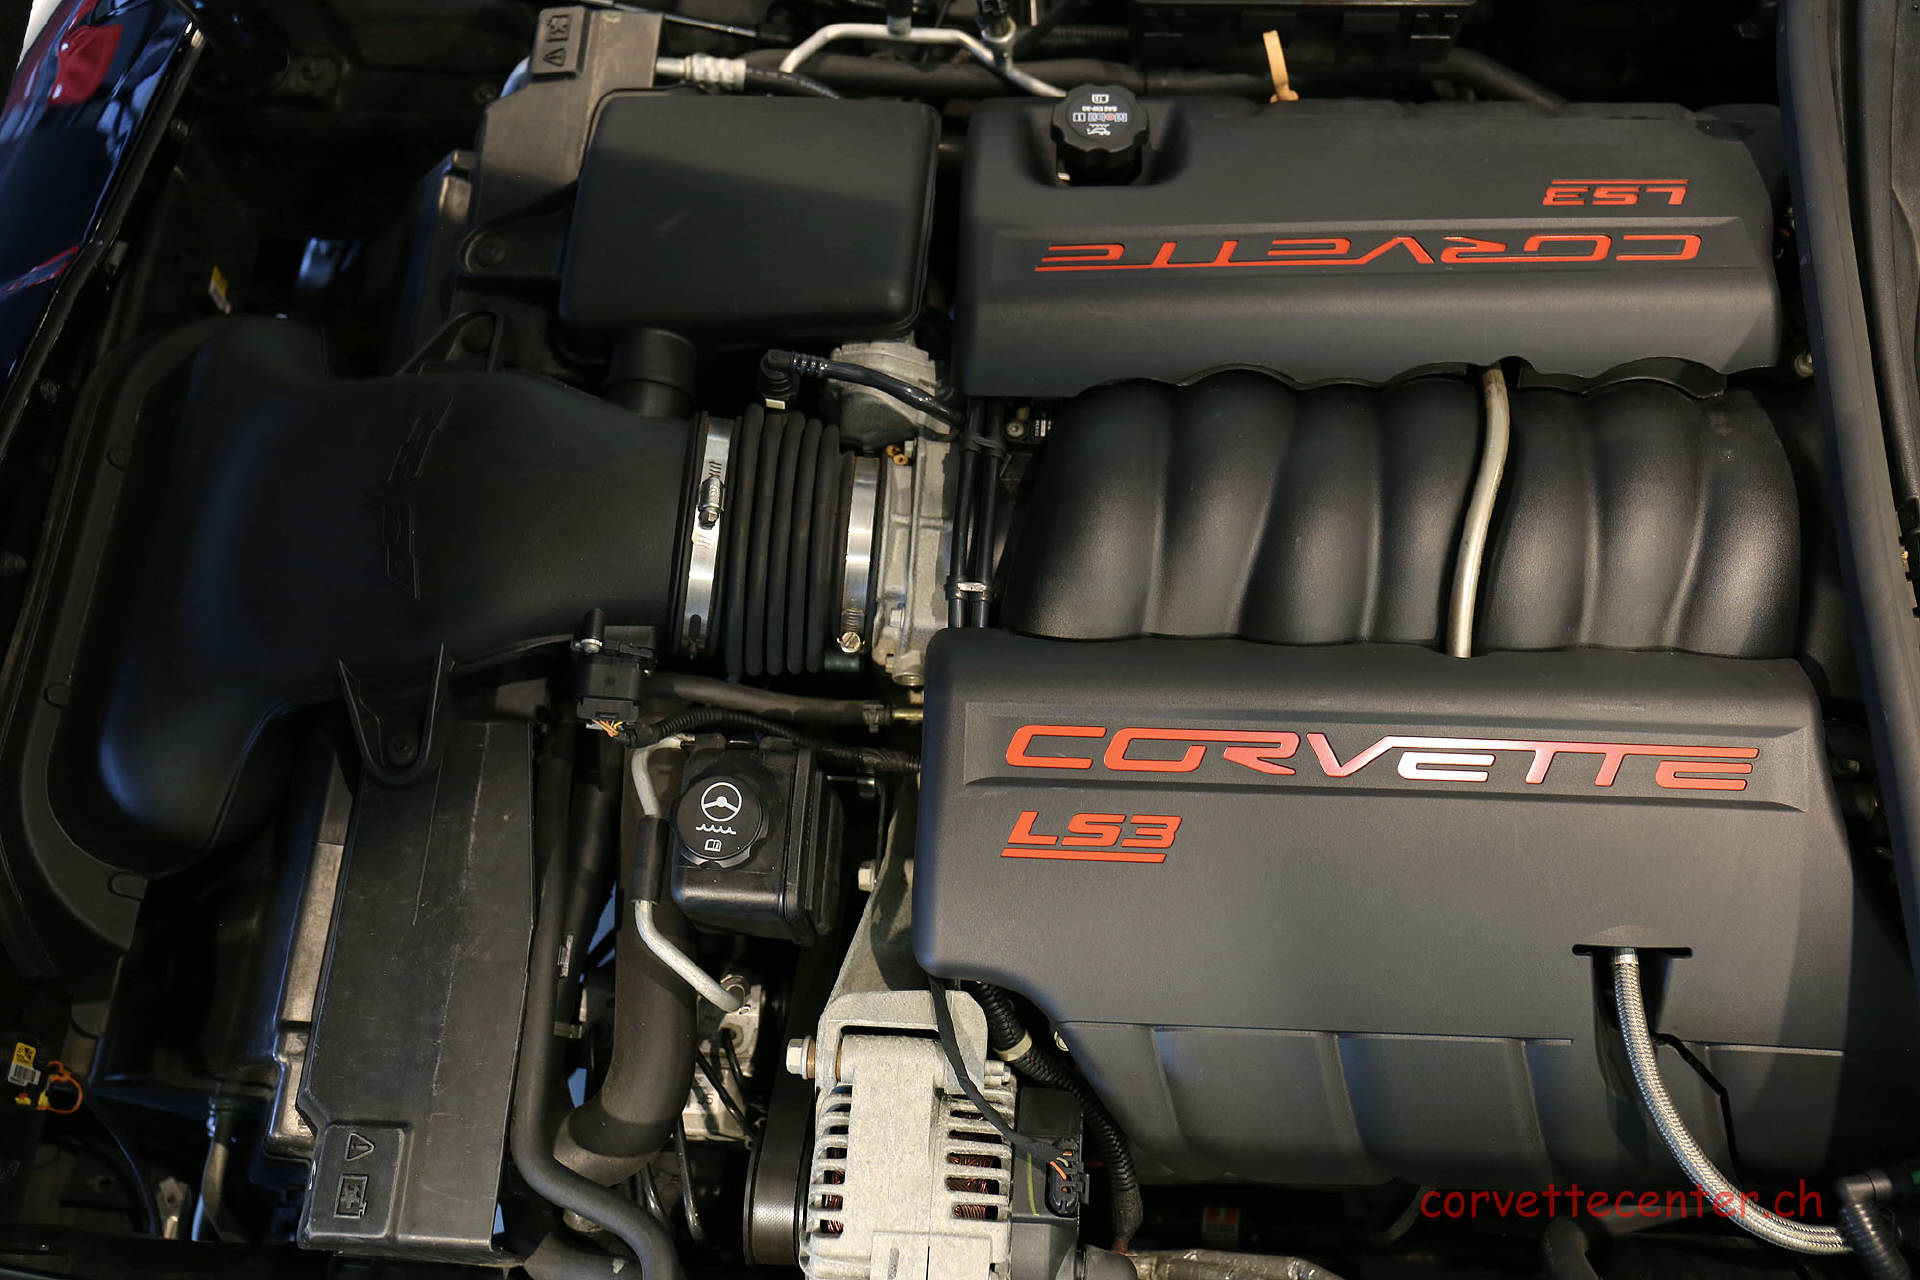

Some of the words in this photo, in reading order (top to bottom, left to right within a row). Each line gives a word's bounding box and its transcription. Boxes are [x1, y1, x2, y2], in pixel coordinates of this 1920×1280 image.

[1542, 182, 1688, 206] LS3
[1034, 233, 1702, 274] CORVETTE
[1005, 724, 1760, 791] CORVETTE
[1002, 811, 1182, 858] LS3
